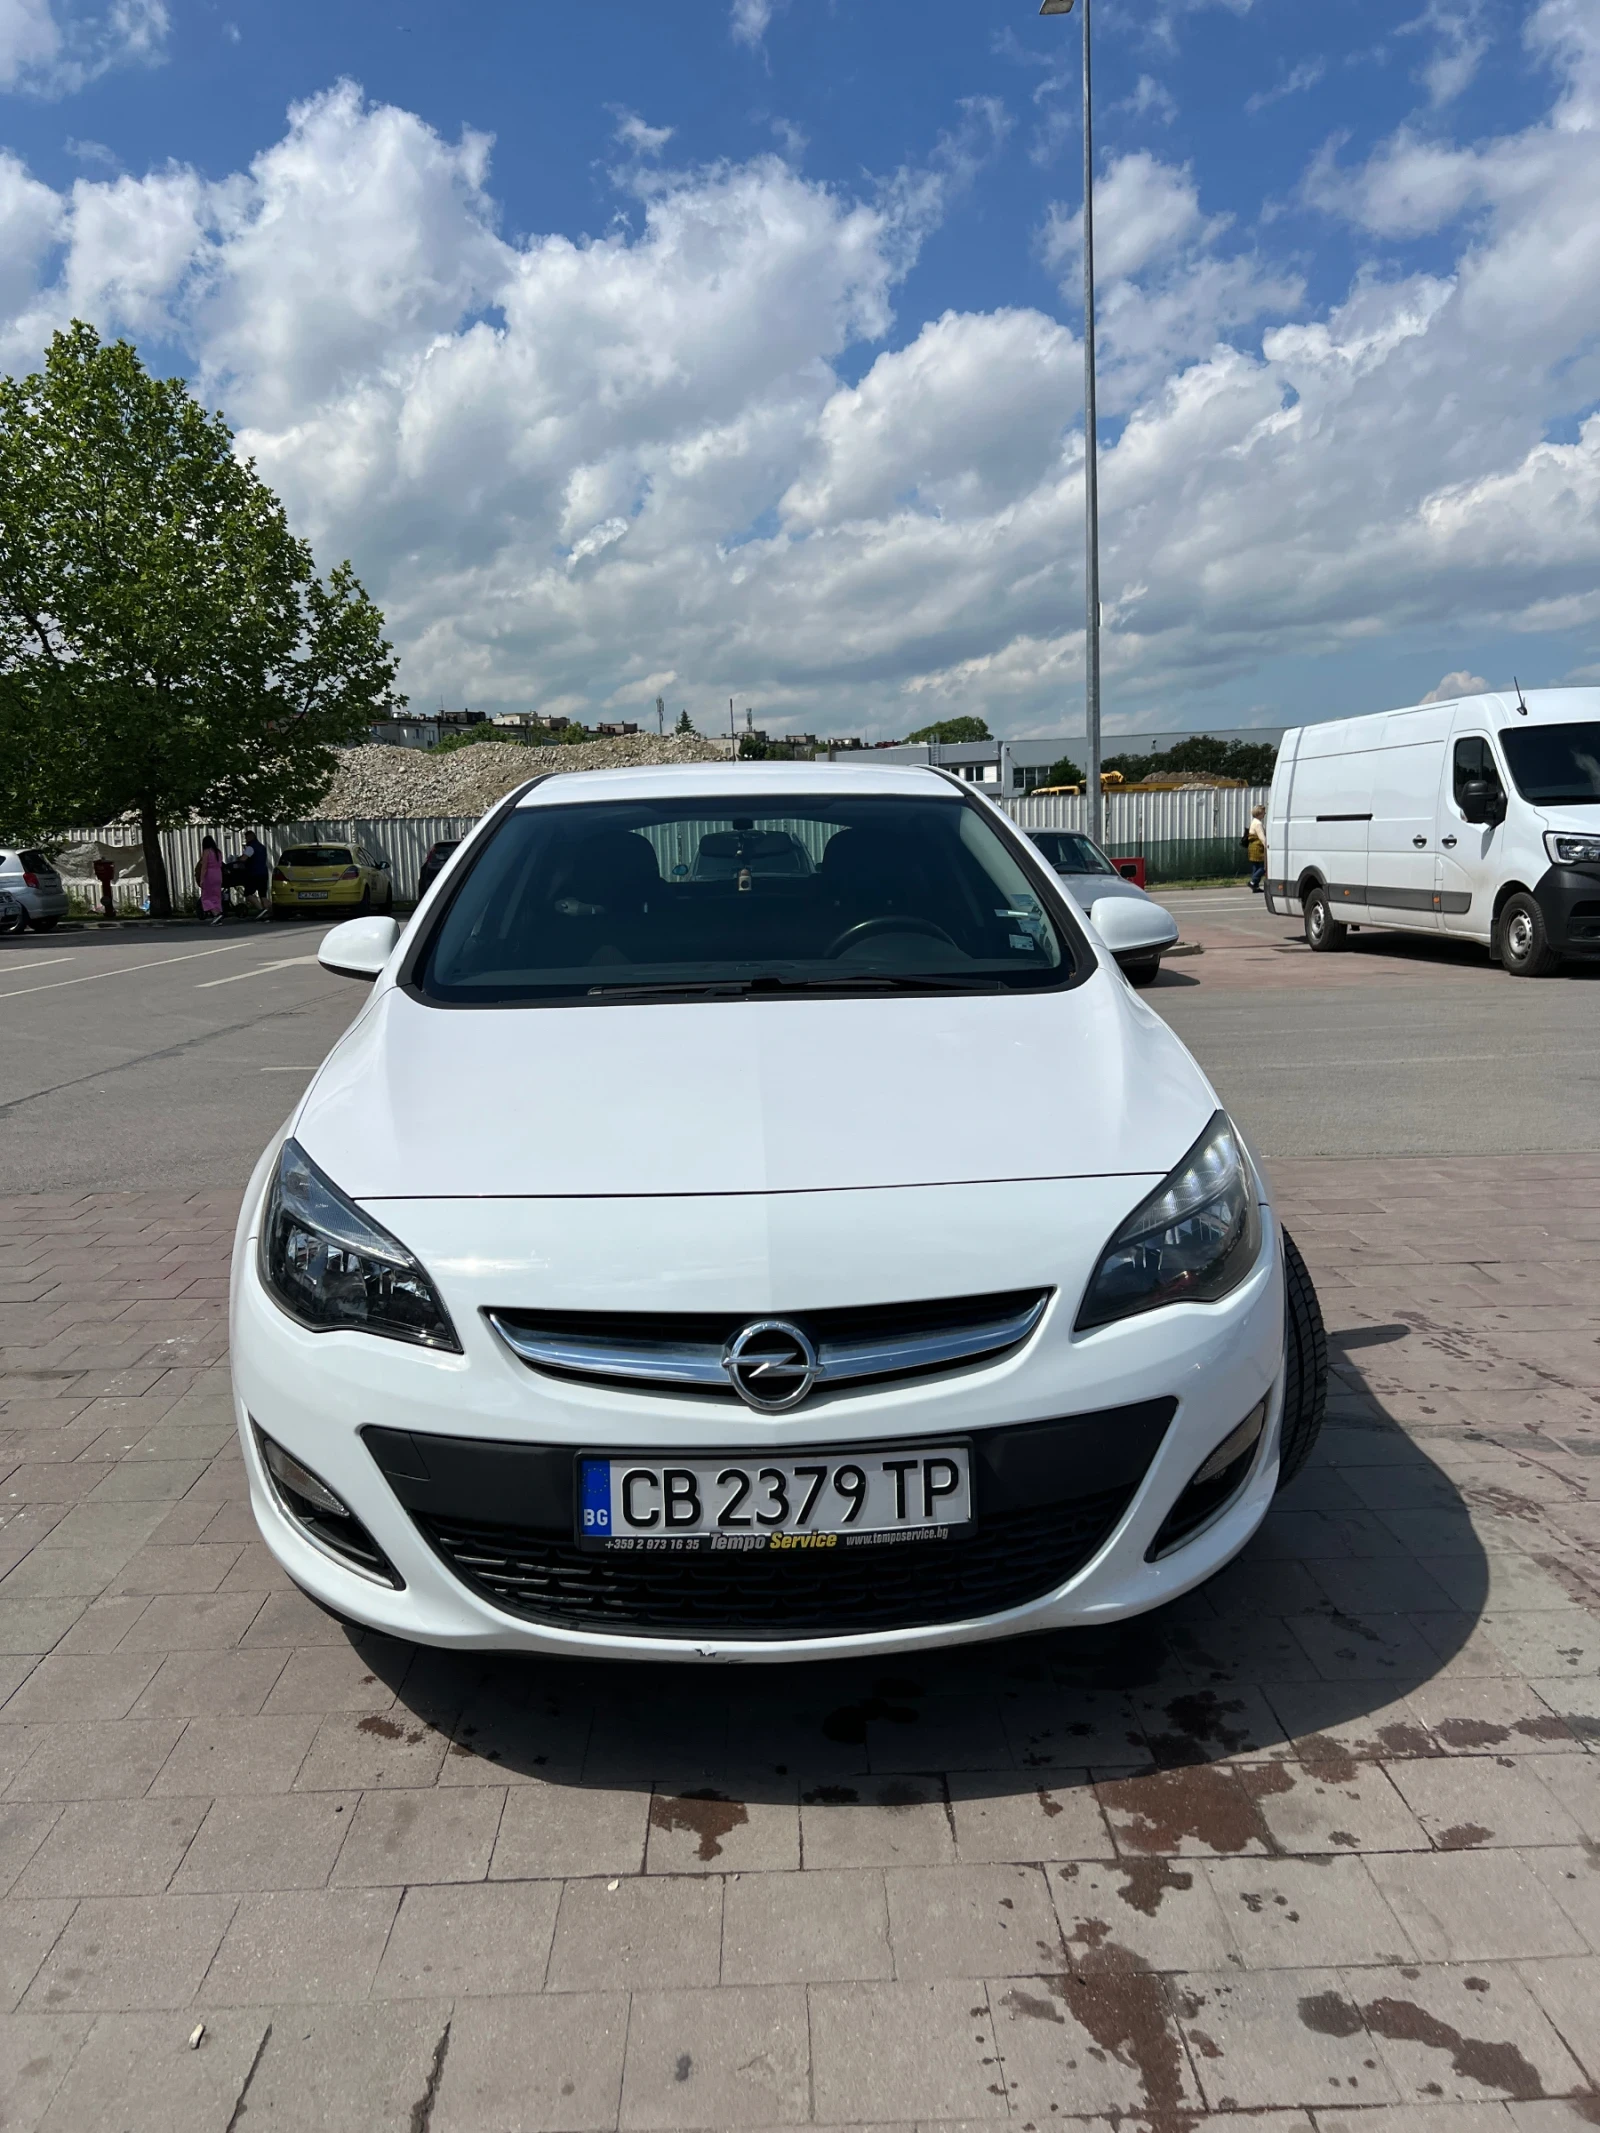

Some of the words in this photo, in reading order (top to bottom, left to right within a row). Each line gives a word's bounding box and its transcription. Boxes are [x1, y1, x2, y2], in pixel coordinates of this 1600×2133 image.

[622, 1468, 701, 1527] CB
[716, 1464, 866, 1526] 2379
[882, 1458, 960, 1519] TP
[583, 1508, 608, 1526] BG
[605, 1539, 633, 1549] +359
[636, 1539, 644, 1549] 2
[647, 1539, 667, 1549] 973
[671, 1539, 683, 1549] 16
[686, 1539, 699, 1549] 35
[710, 1533, 766, 1551] Tempo
[770, 1531, 837, 1549] Service
[846, 1528, 948, 1546] www.temposervice.bg
